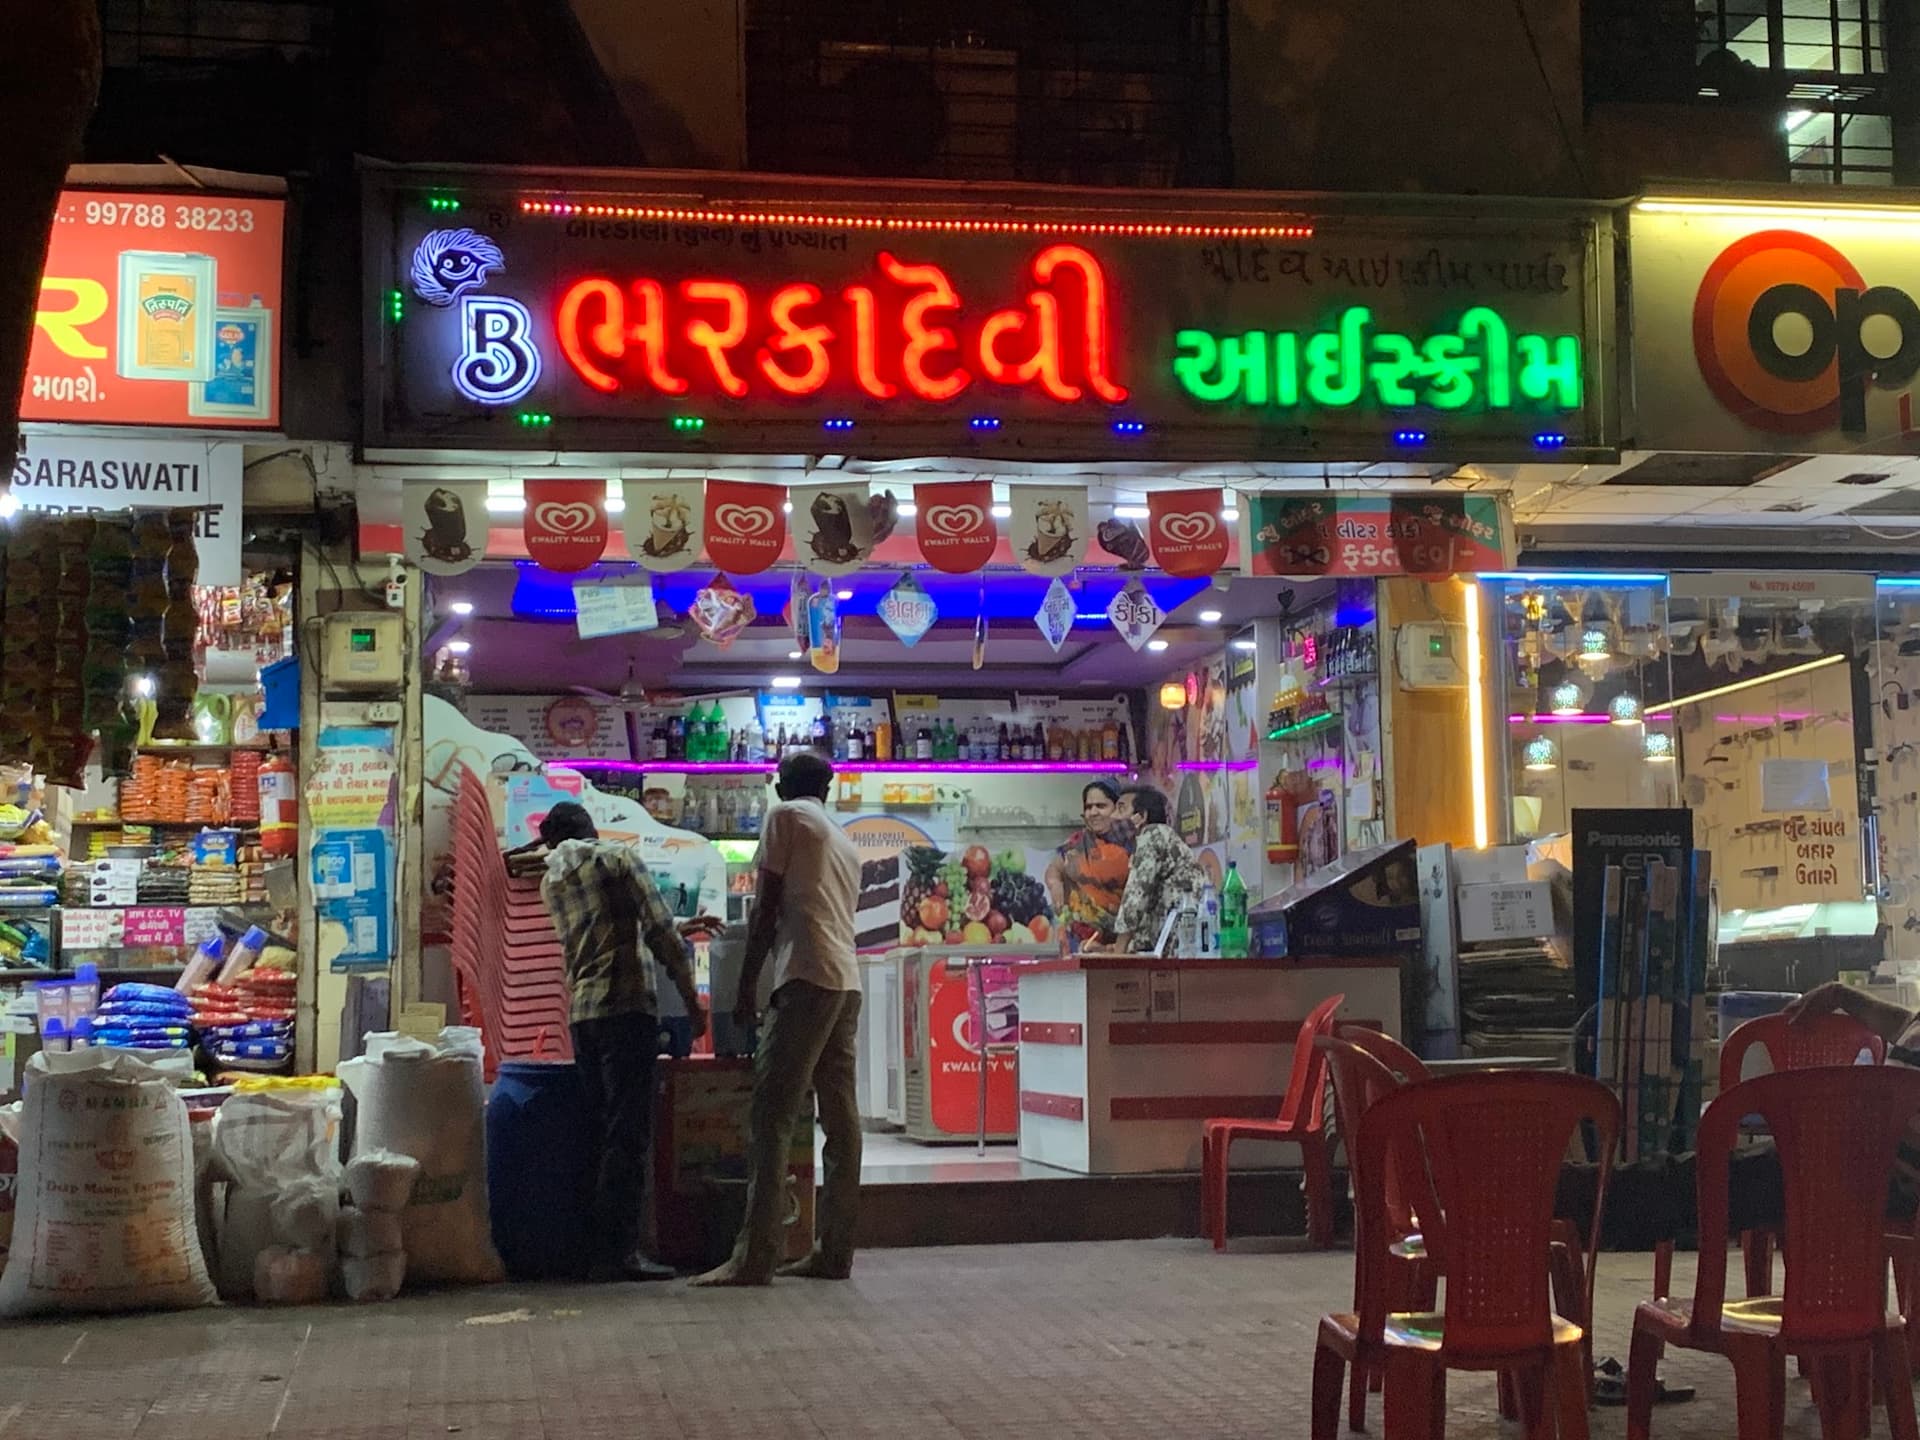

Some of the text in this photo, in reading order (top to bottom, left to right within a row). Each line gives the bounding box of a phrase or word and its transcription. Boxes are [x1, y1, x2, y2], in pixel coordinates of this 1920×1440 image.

[85, 201, 165, 228] 99788
[175, 206, 254, 232] 38233
[556, 243, 1128, 404] ભરકાદેવી
[1174, 306, 1583, 411] આઈસ્ક્રીમ
[13, 457, 199, 493] SARASWATI
[531, 536, 569, 545] KWALITY
[710, 536, 747, 545] KWALITY
[924, 537, 961, 547] KWALITY
[1114, 590, 1158, 625] કોકો
[1811, 817, 1846, 837] ચંપલ
[1586, 830, 1682, 847] Panasonic
[1796, 843, 1836, 860] બહાર
[1795, 862, 1839, 886] ઉતારો
[168, 909, 181, 918] TV
